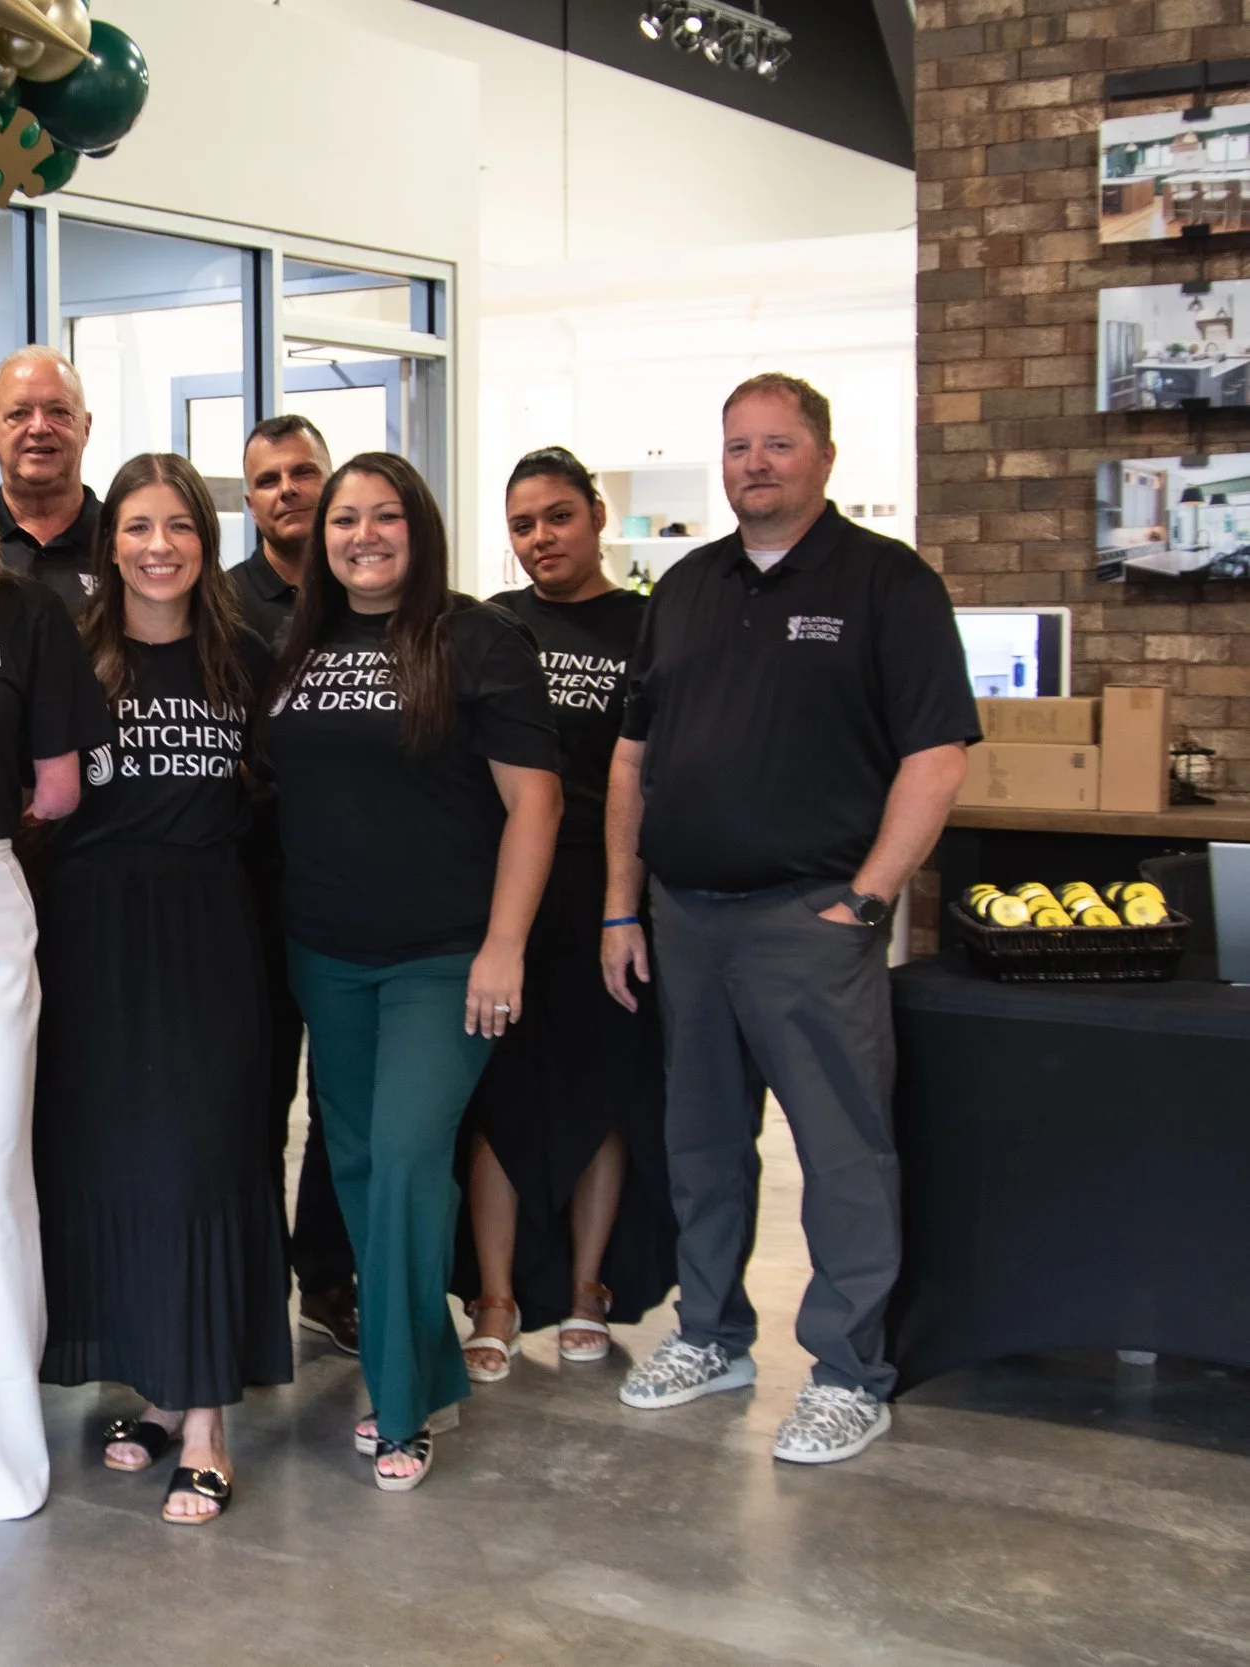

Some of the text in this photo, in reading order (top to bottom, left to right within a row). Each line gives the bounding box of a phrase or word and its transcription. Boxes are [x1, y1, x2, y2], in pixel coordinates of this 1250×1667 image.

[292, 692, 311, 710] &
[548, 688, 610, 713] SIGN
[119, 726, 243, 752] KITCHENS
[121, 755, 141, 777] &
